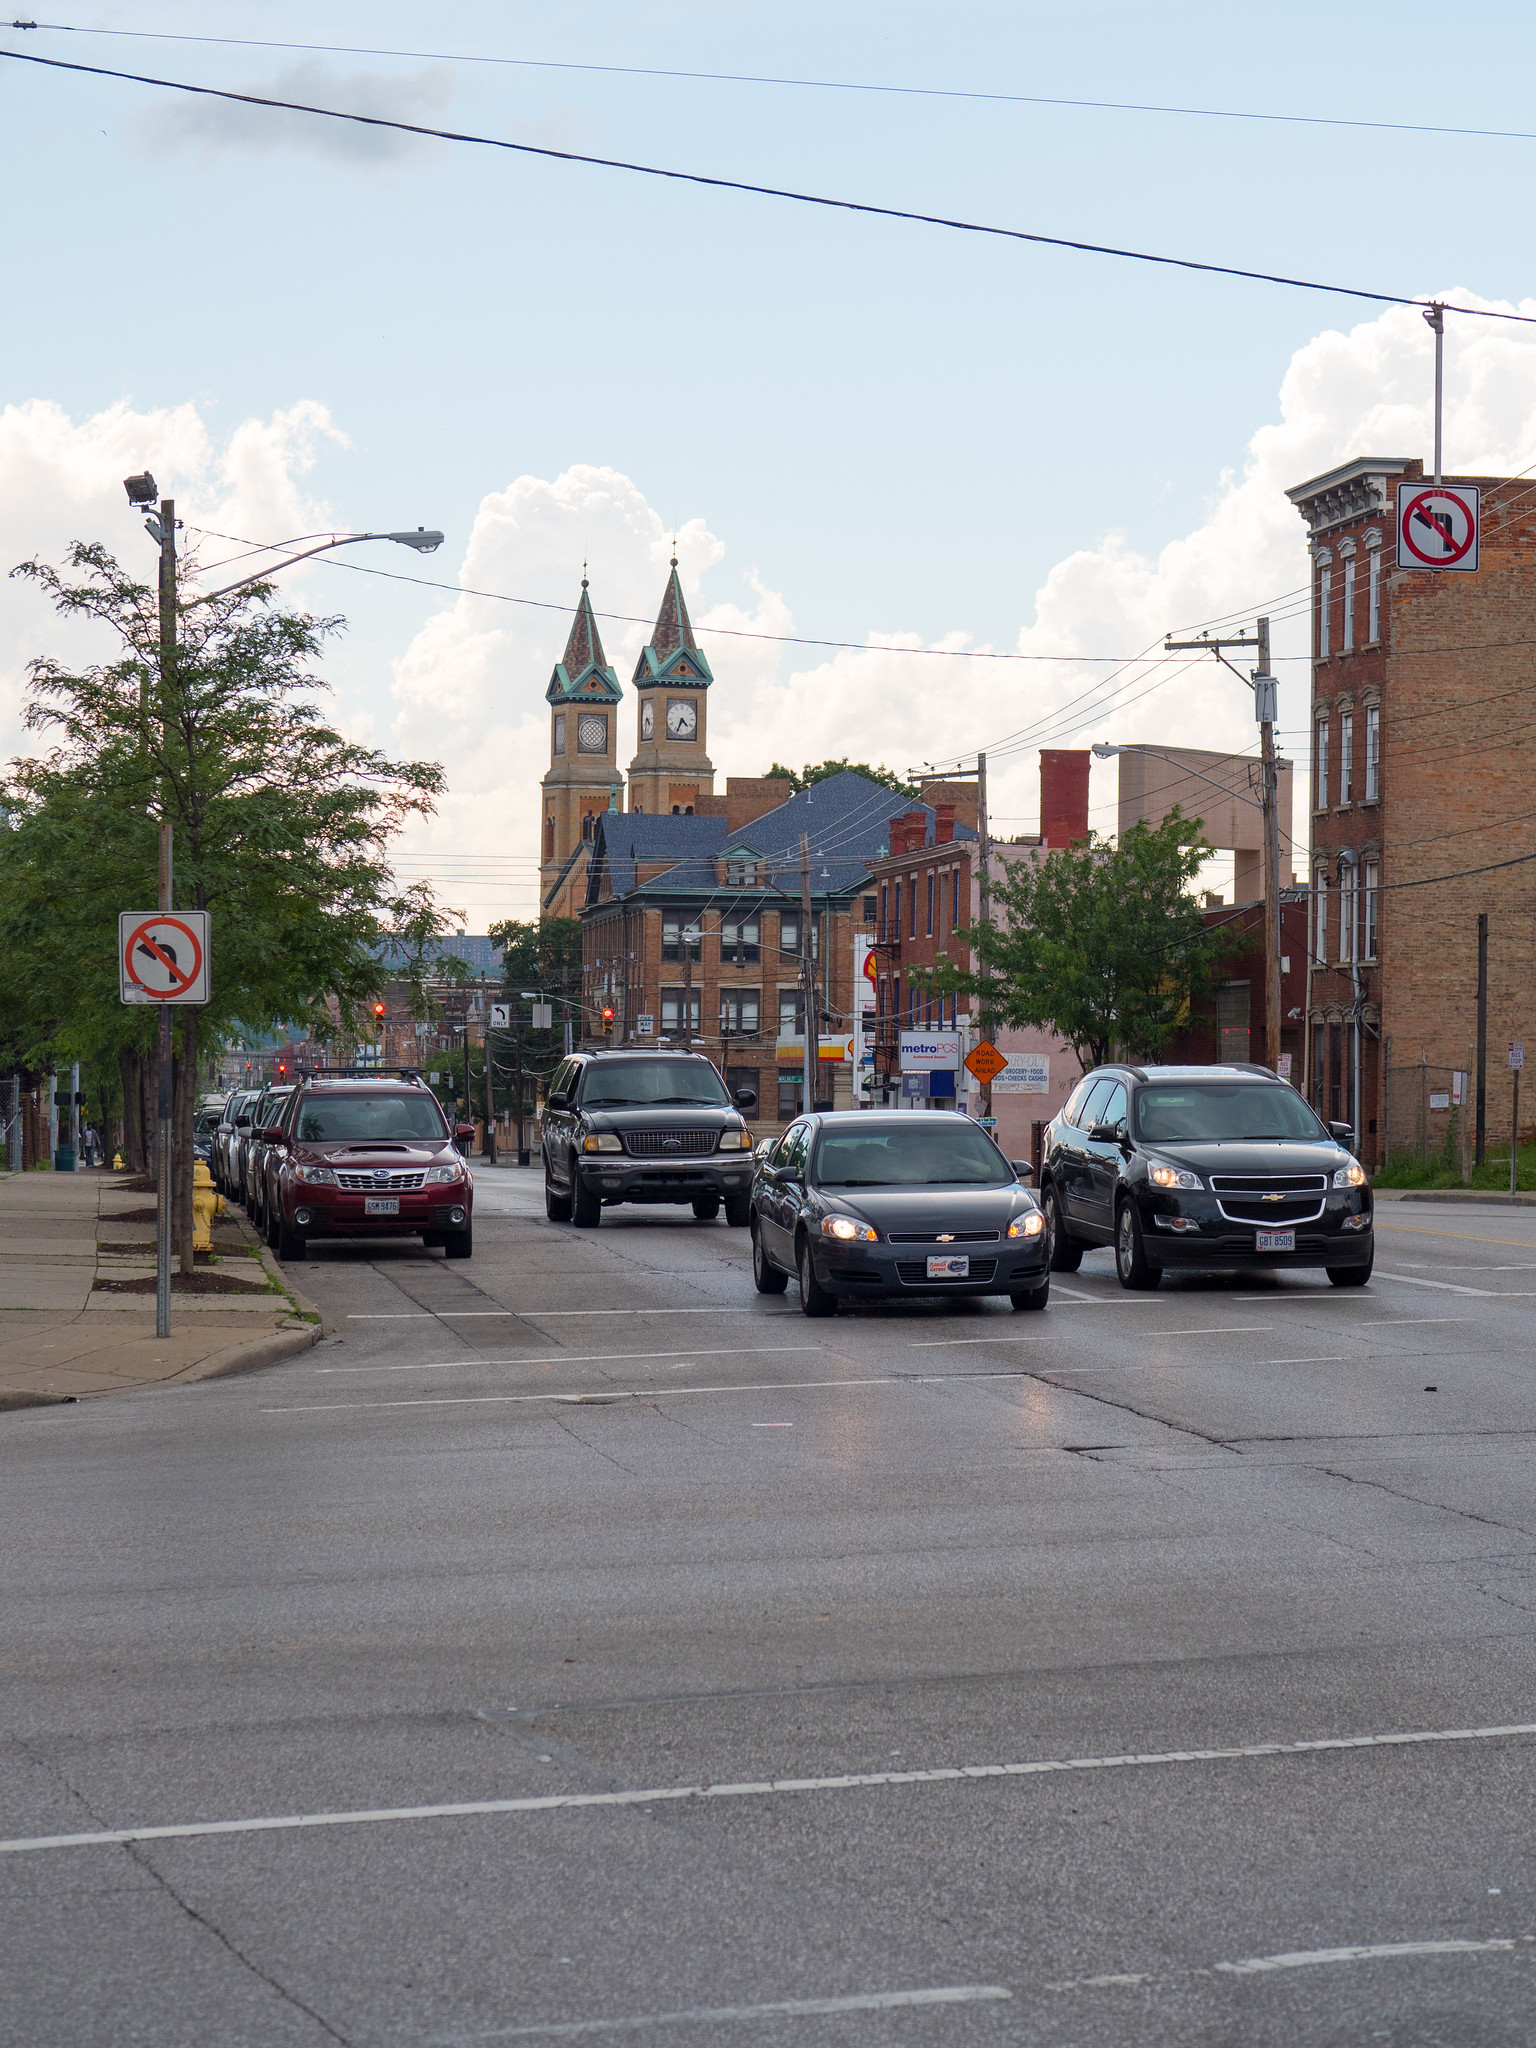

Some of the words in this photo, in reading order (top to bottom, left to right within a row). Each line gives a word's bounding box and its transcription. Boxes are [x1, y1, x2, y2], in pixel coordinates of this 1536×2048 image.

[901, 1043, 958, 1054] metroPCS
[367, 1201, 380, 1211] GSM
[381, 1201, 397, 1211] 9476
[1259, 1236, 1272, 1246] GBT
[1274, 1235, 1293, 1246] 8509
